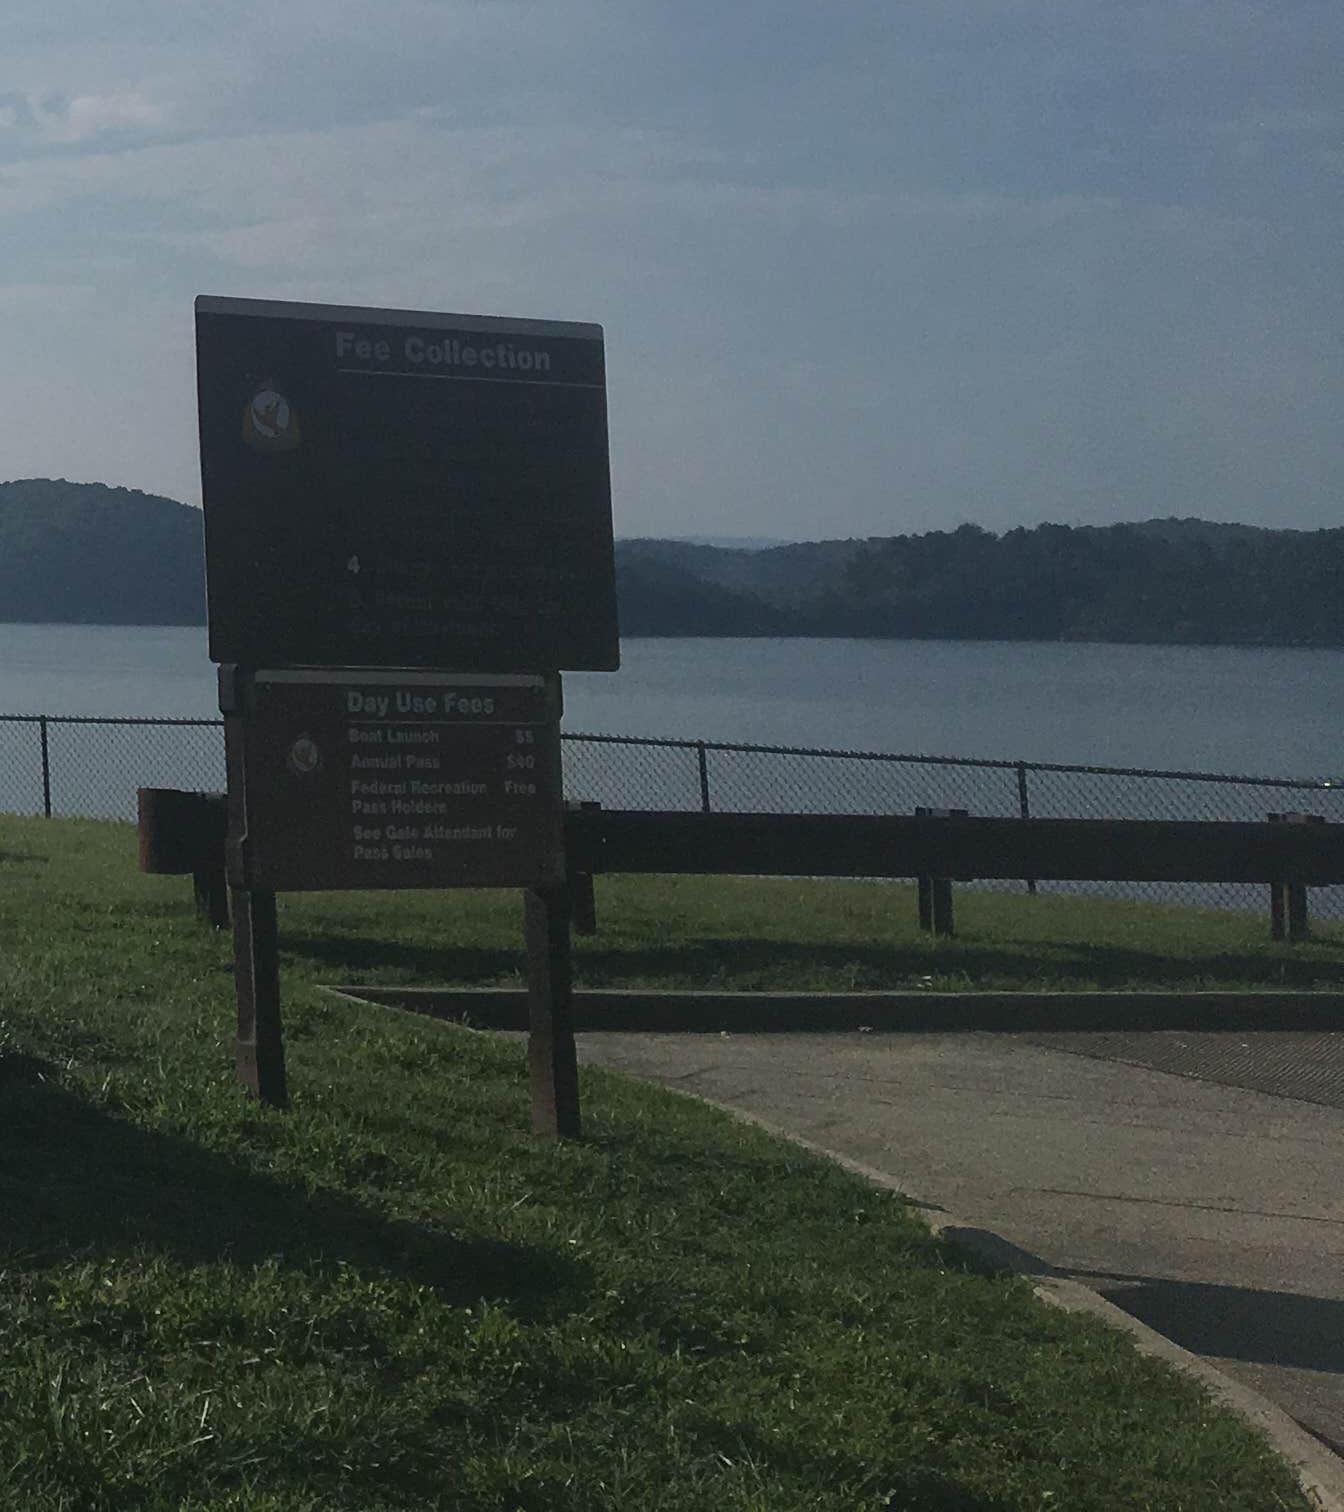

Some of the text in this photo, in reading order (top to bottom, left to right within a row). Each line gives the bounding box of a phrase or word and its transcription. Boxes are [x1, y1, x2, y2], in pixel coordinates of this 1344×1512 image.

[335, 331, 552, 371] Fee Collection
[347, 691, 495, 716] Day Use Fees
[387, 728, 440, 744] Launch
[350, 754, 441, 769] Annual Pass
[351, 779, 488, 795] Federal Recreation
[504, 779, 537, 795] Free
[351, 799, 448, 815] Pass Holders
[423, 824, 493, 840] Attendant
[353, 845, 390, 860] Pass
